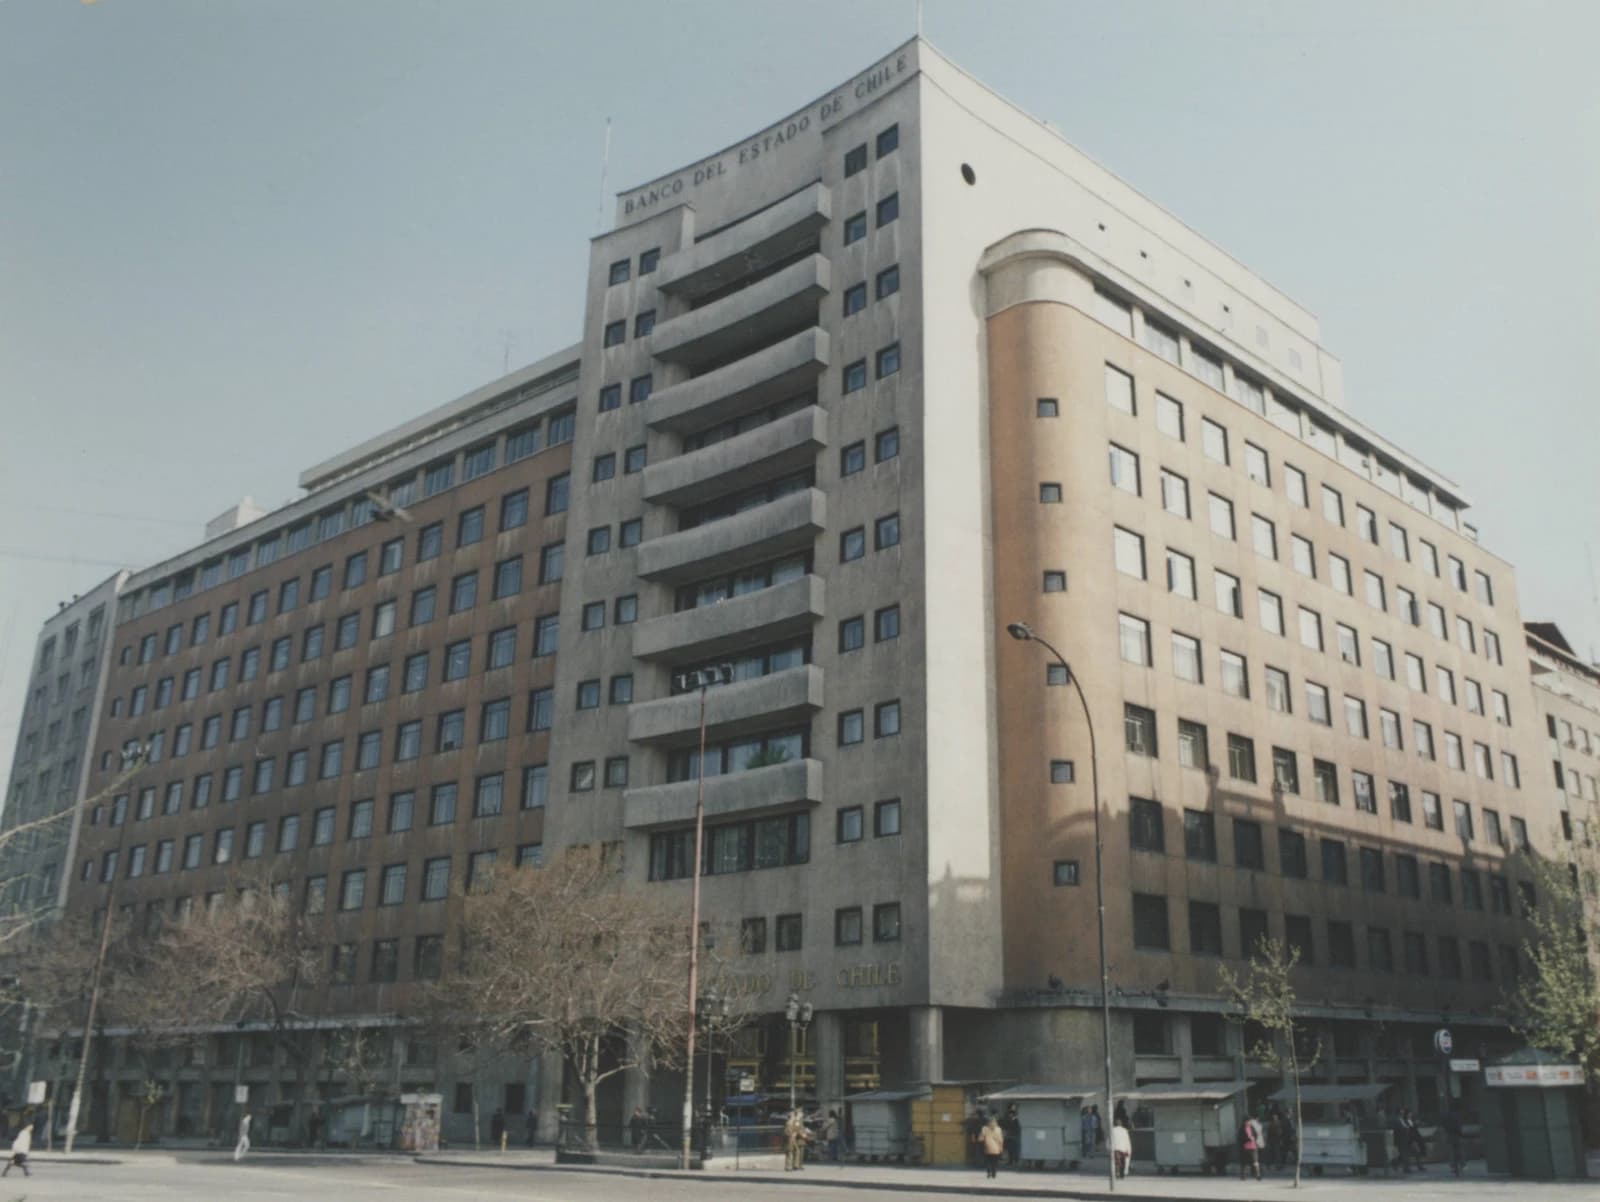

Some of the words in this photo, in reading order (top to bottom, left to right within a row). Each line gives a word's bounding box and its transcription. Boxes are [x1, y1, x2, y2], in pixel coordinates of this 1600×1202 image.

[624, 180, 683, 214] BANCO
[694, 163, 727, 187] DEL
[739, 116, 810, 165] ESTADO
[820, 96, 843, 121] DE
[854, 54, 907, 99] CHILE
[789, 969, 816, 993] DE
[836, 961, 902, 988] CHILE
